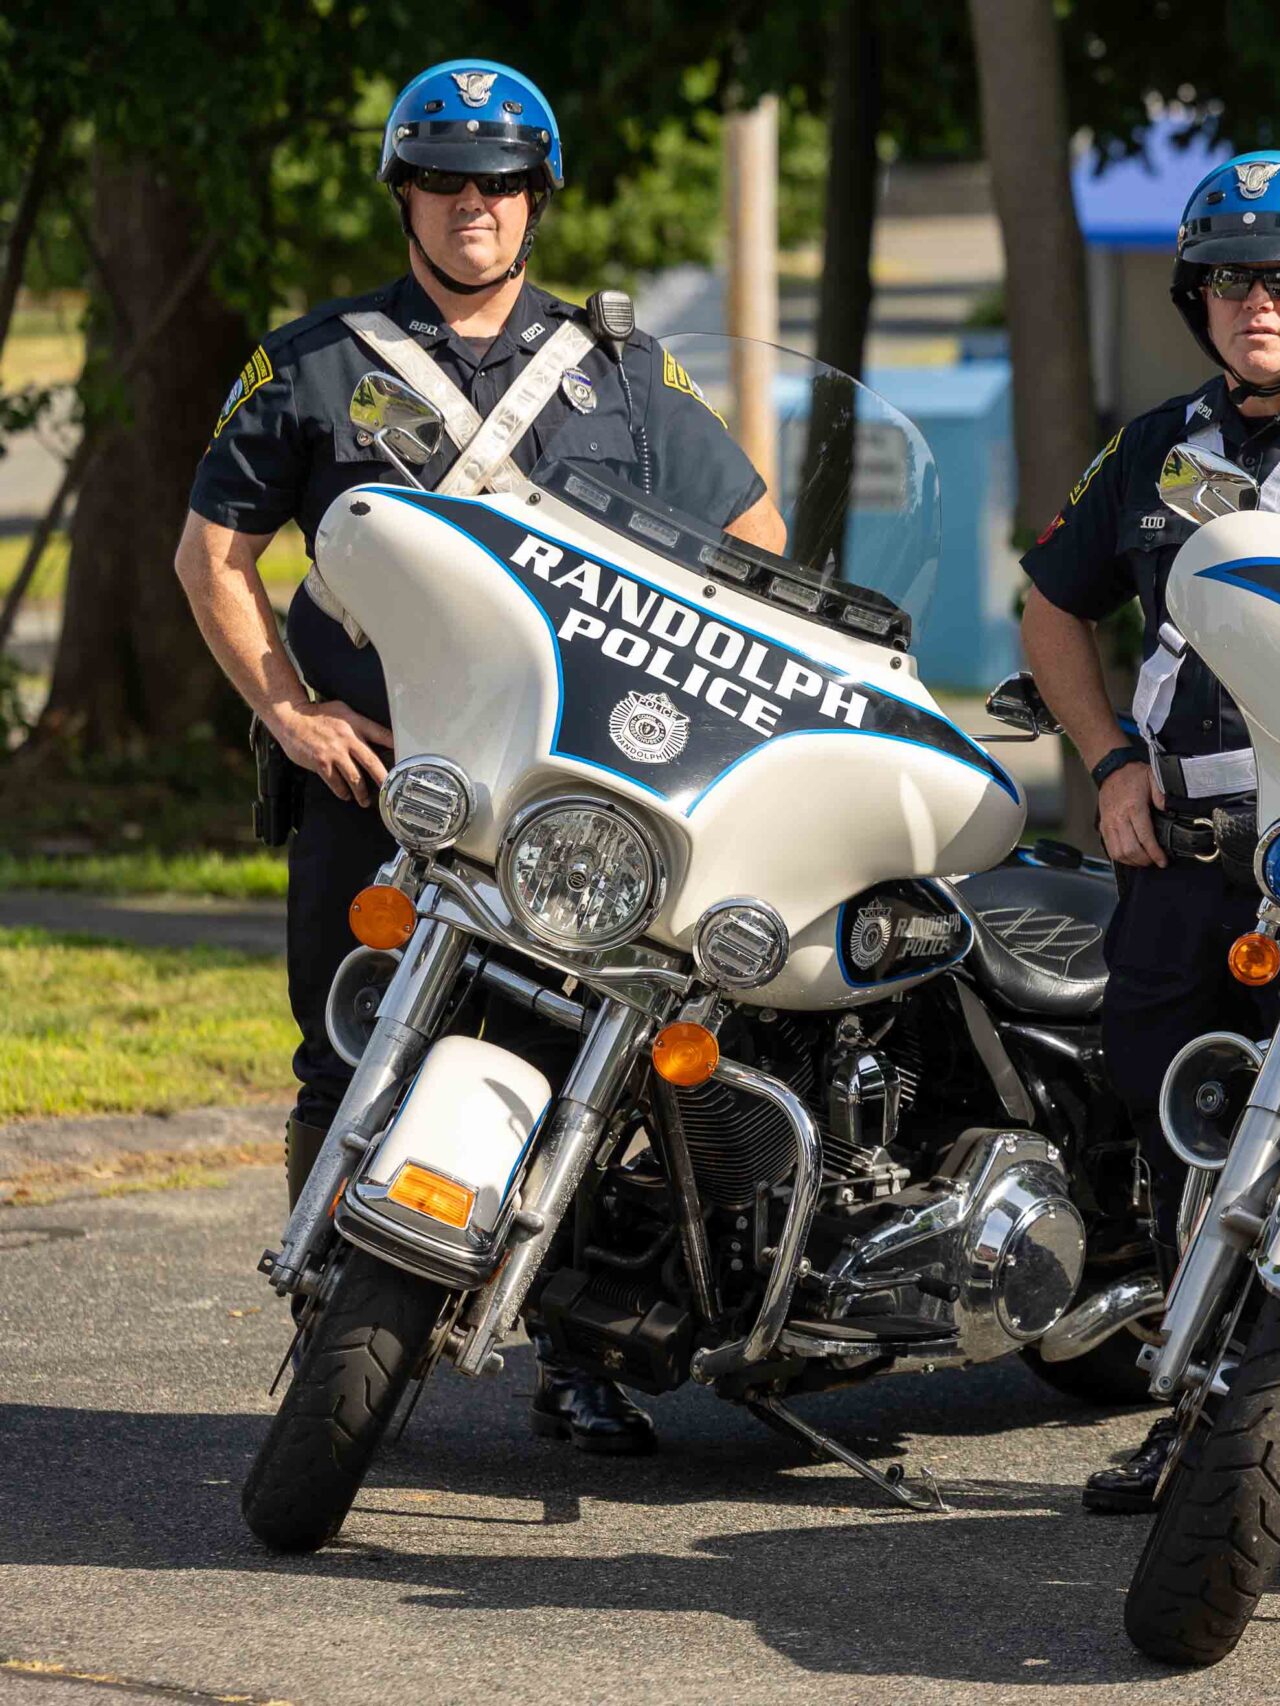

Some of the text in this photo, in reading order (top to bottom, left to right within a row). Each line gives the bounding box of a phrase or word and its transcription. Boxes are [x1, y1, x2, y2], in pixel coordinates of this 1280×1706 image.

[509, 534, 869, 728] RANDOLPH
[557, 607, 783, 738] POLICE
[640, 697, 678, 719] POLICE
[614, 734, 663, 759] RANDOLPH
[894, 913, 961, 937] RANDOLPH
[900, 936, 949, 958] POLICE
